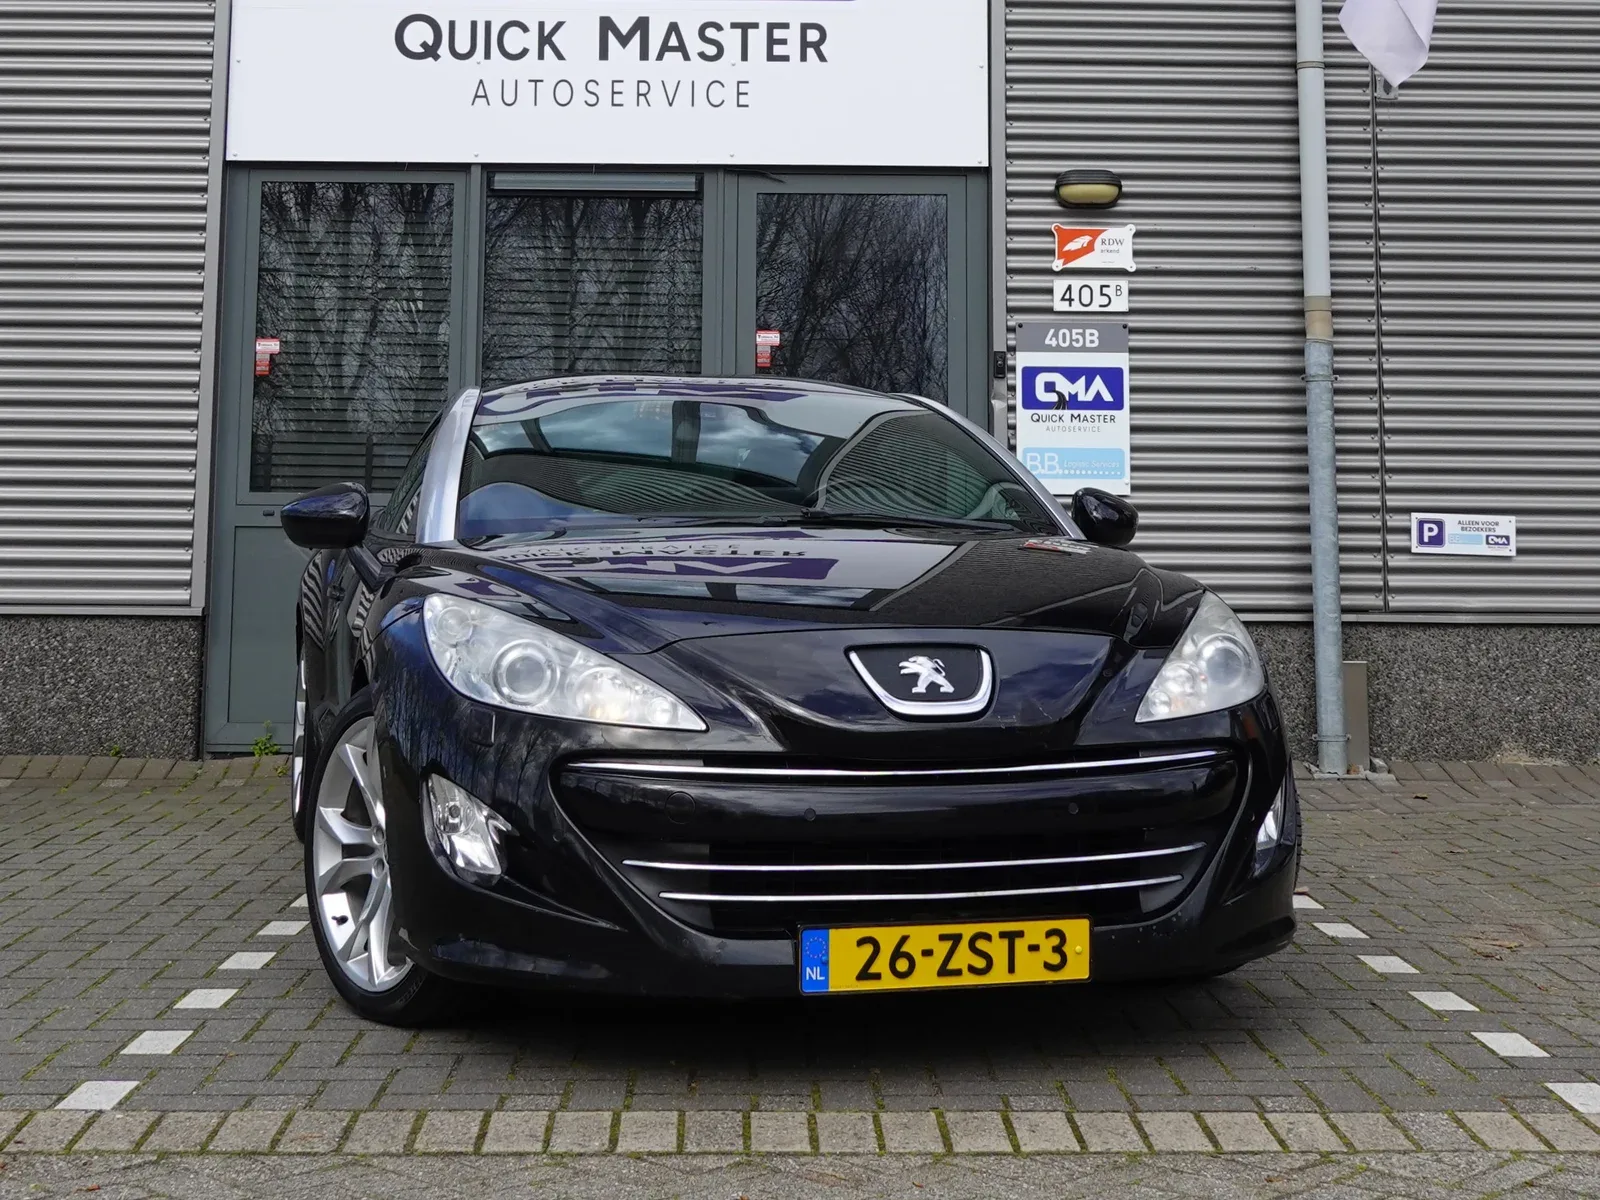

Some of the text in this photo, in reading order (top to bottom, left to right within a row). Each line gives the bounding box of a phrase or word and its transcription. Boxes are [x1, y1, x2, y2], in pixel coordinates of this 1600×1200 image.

[395, 13, 828, 62] QUICK MASTER
[471, 79, 750, 108] AUTOSERVICE
[1101, 237, 1125, 246] RDW
[1044, 328, 1100, 348] 405B
[1030, 412, 1116, 424] QUICK MASTER
[1045, 425, 1102, 433] AUTOSERVICE
[1423, 523, 1439, 543] P
[855, 927, 1068, 982] 26-ZST-3
[805, 966, 826, 981] NL
